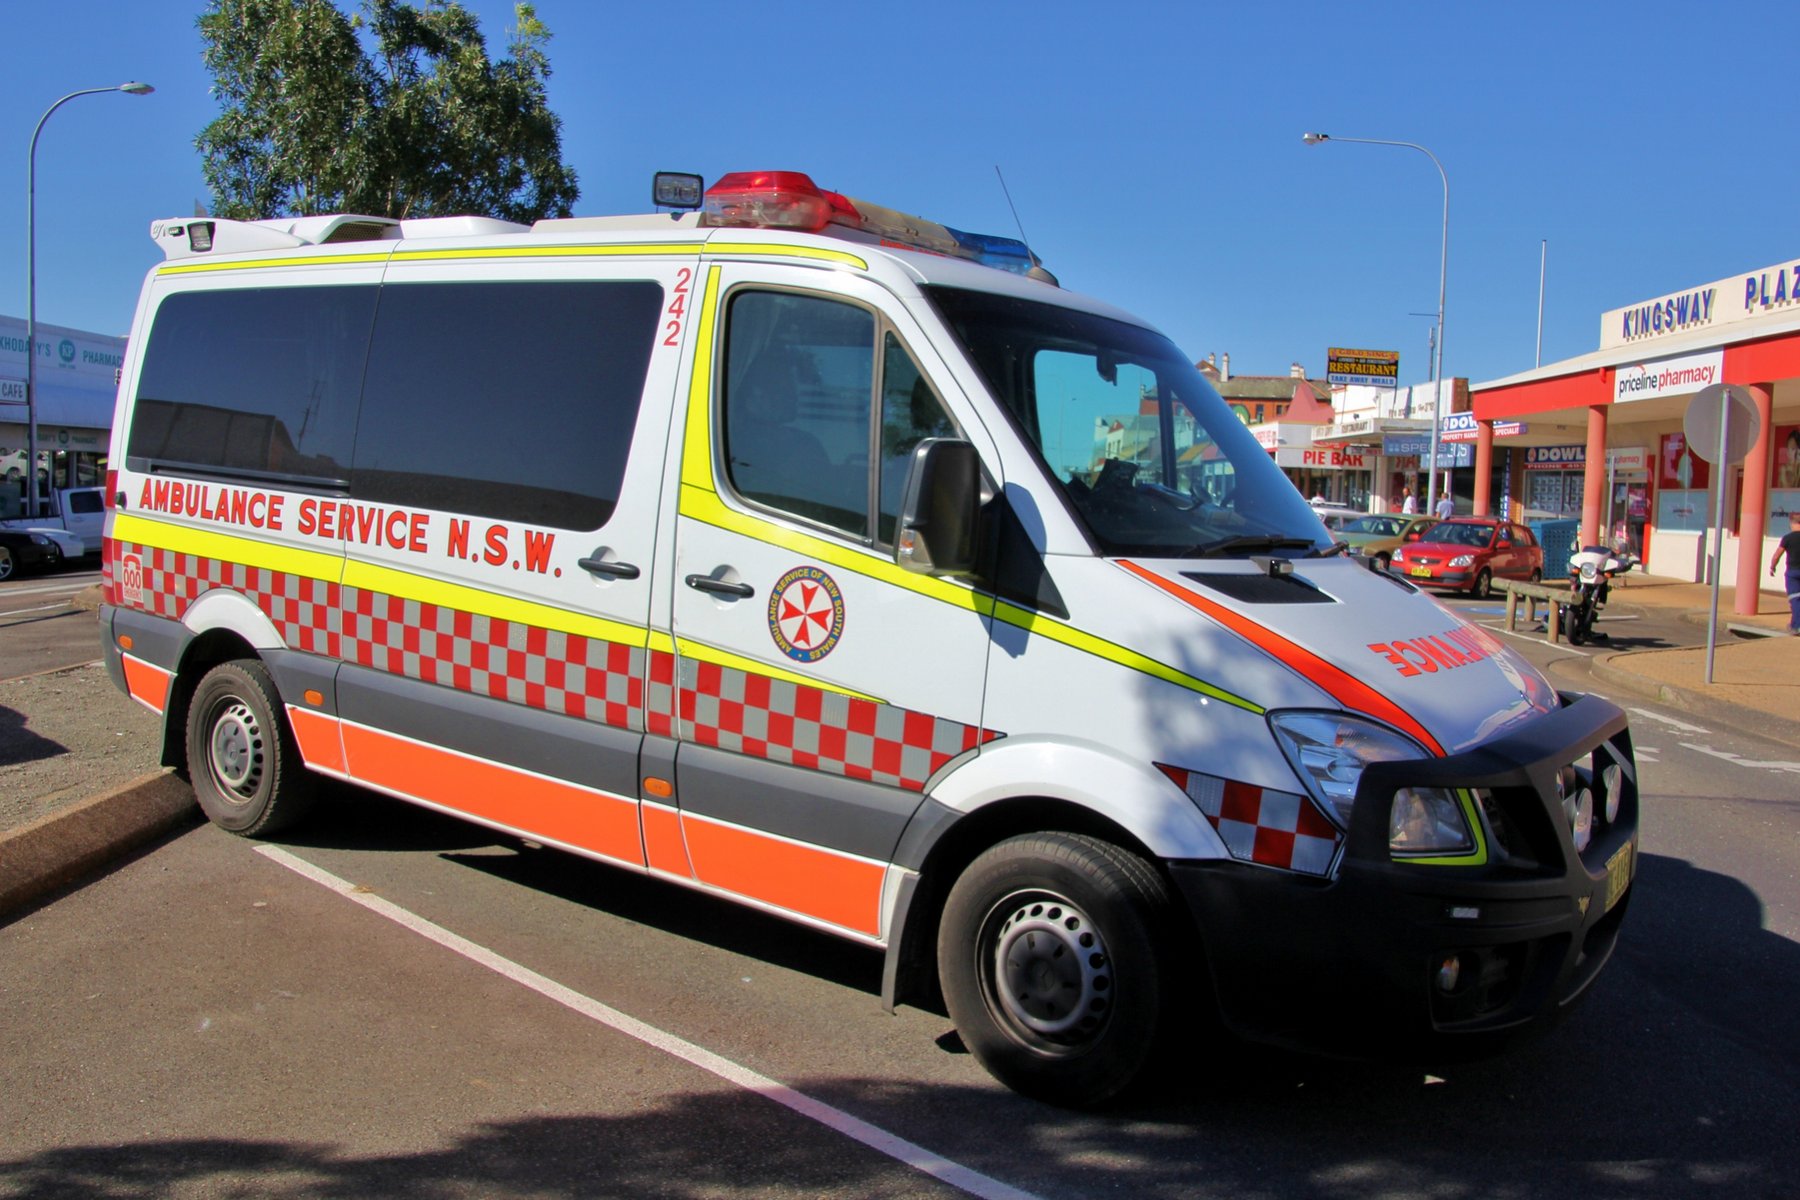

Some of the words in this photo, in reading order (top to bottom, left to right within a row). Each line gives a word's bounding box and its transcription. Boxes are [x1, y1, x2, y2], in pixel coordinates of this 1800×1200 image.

[663, 267, 691, 346] 242
[1623, 288, 1713, 338] KINGSWAY
[1745, 265, 1800, 310] PLAZ
[83, 350, 122, 368] PHARMAC
[1329, 362, 1397, 376] RESTAURANT
[2, 383, 23, 398] CAFE
[1619, 373, 1658, 398] priceline
[1658, 365, 1716, 391] pharmacy
[1442, 433, 1463, 441] PROPERTY
[1303, 451, 1326, 465] PIE
[1331, 452, 1363, 467] BAR
[139, 478, 284, 530] AMBULANCE
[298, 499, 429, 553] SERVICE
[447, 518, 562, 578] N.S.W.
[124, 568, 141, 589] 000
[776, 568, 809, 592] SERVICE
[810, 569, 823, 580] OF
[822, 575, 839, 598] NEW
[809, 637, 837, 660] WALES
